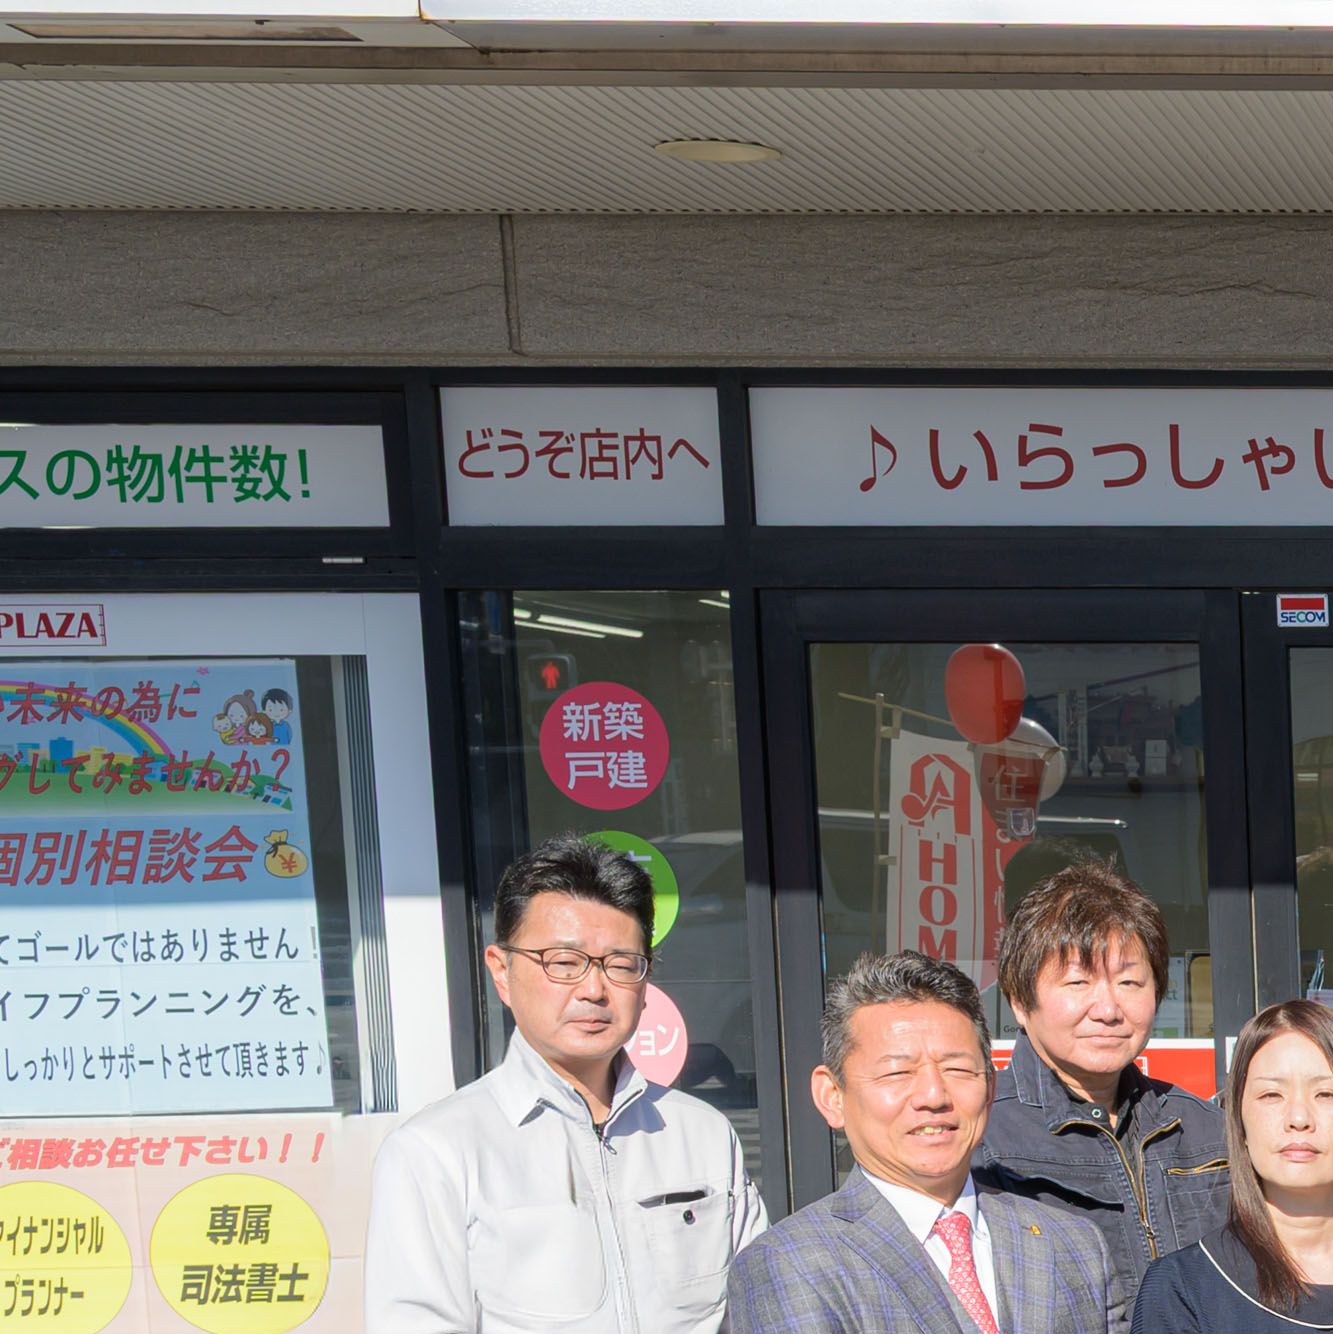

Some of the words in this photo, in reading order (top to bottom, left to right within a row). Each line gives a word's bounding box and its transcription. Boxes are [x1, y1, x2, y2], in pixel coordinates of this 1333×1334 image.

[458, 427, 710, 480] どうぞ店内へ
[0, 612, 98, 638] PLAZA
[1280, 611, 1326, 623] SECOM
[0, 681, 200, 725] 未来の為に
[563, 702, 645, 742] 新築
[565, 750, 648, 790] 戸建
[0, 825, 258, 887] 個別相談会
[626, 1023, 679, 1056] ョン
[206, 1204, 273, 1246] 専属
[4, 1274, 85, 1317] プランナー
[180, 1262, 310, 1306] 司法書士
